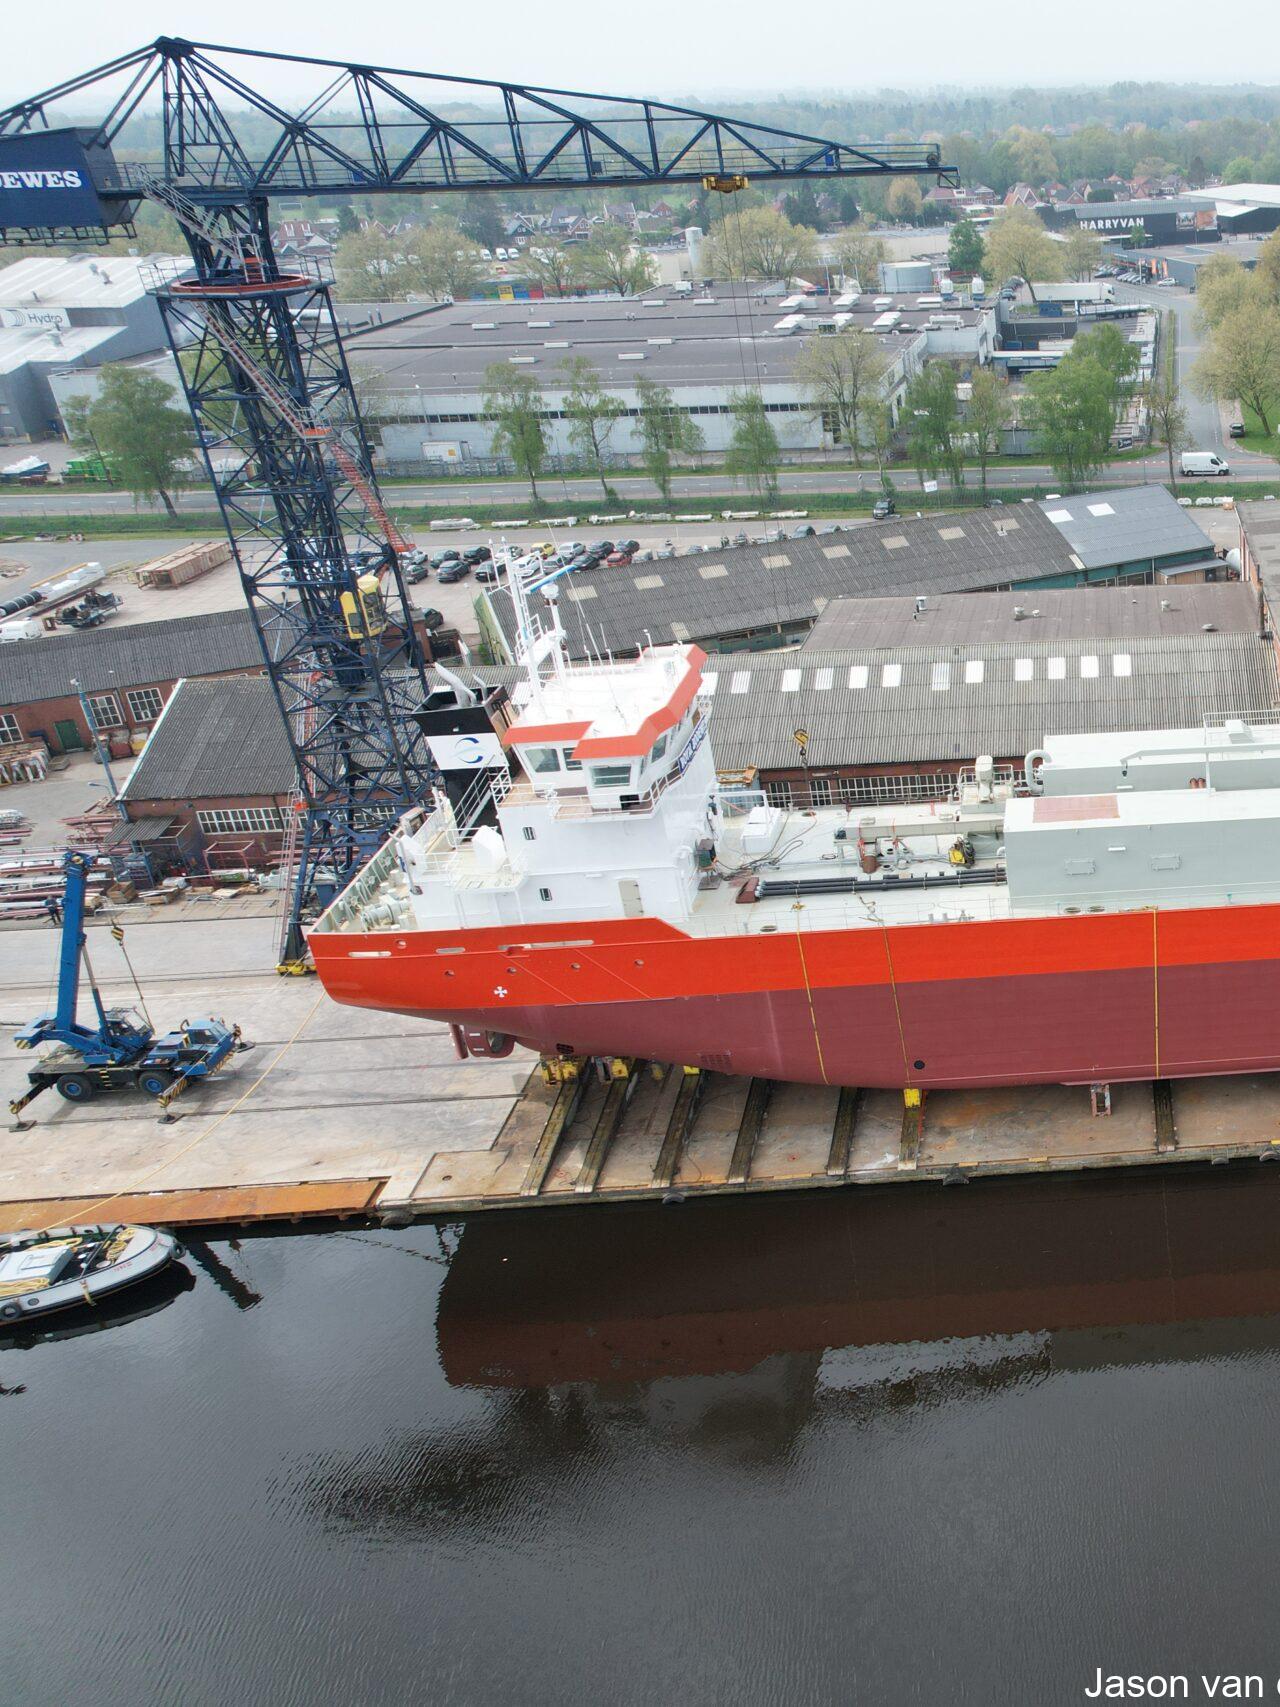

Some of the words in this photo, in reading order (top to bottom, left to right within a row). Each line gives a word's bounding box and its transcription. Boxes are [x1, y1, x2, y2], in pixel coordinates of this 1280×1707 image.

[0, 170, 82, 189] EWES
[1080, 217, 1144, 230] HARRYVAN
[28, 313, 63, 324] Hydro
